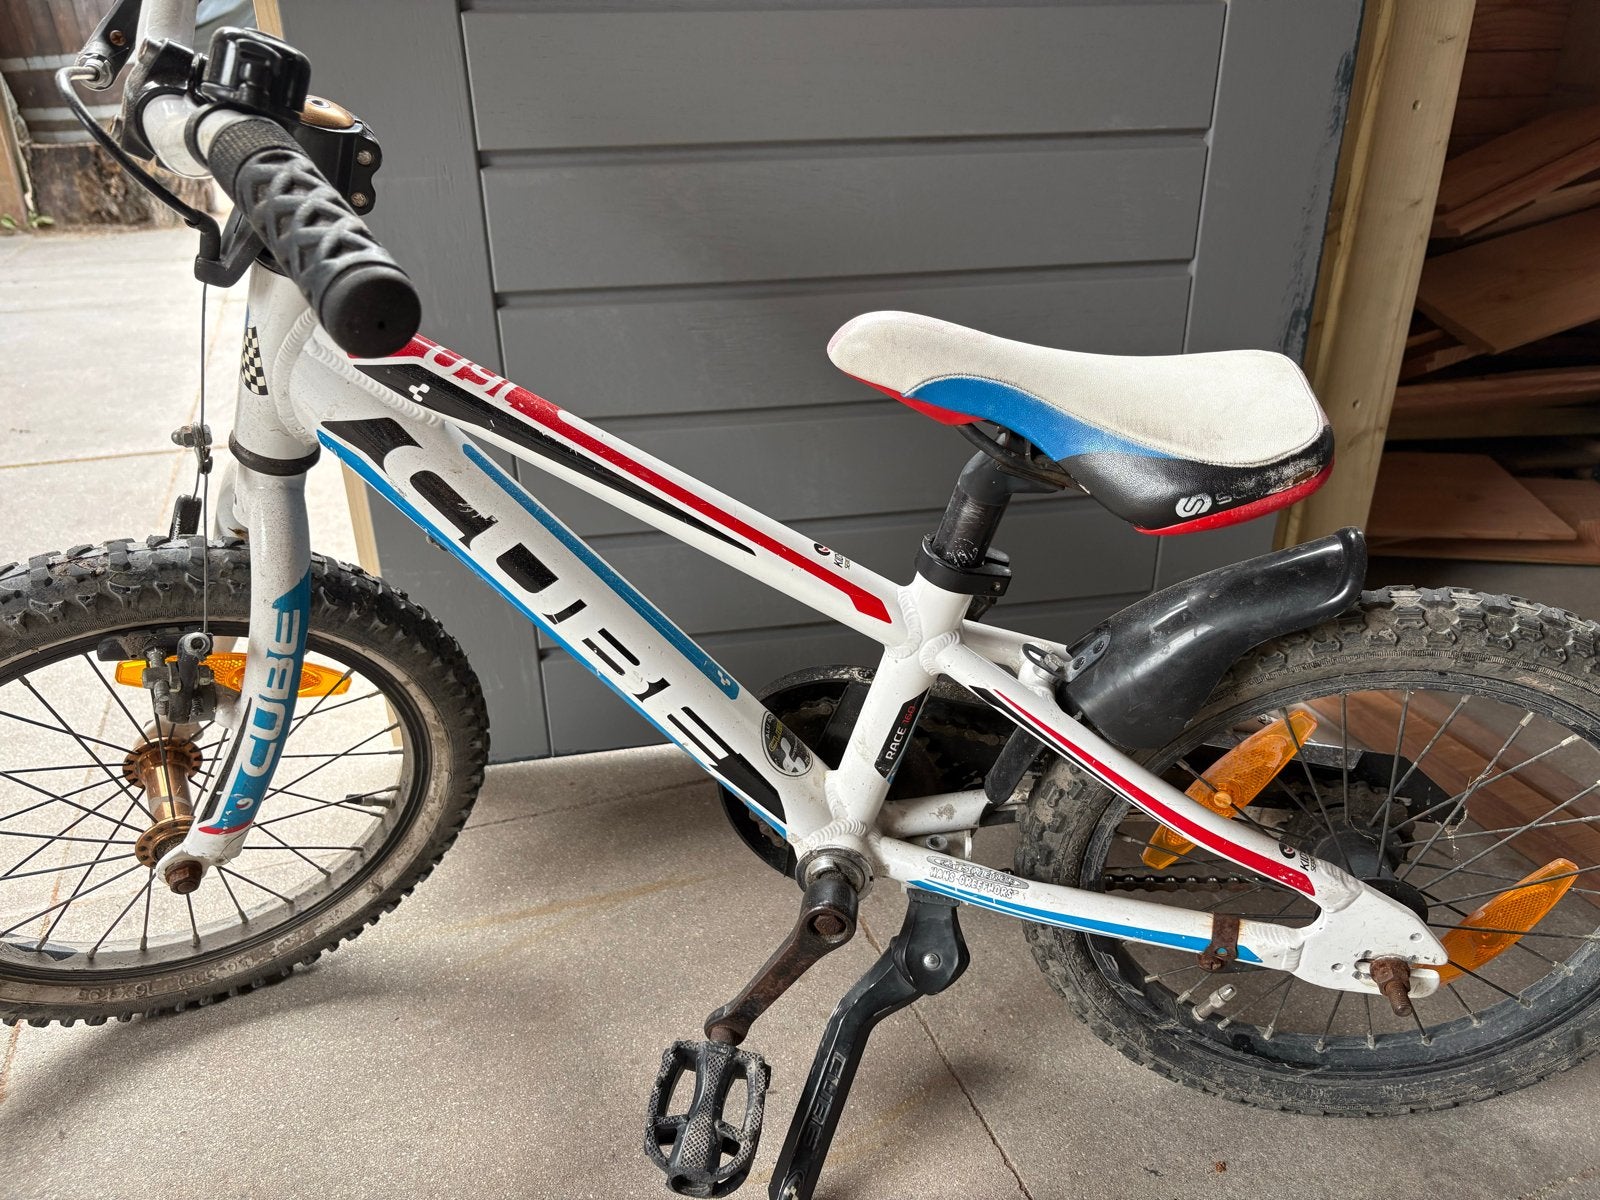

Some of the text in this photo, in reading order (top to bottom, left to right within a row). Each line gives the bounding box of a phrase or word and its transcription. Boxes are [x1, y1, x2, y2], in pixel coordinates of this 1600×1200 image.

[383, 444, 740, 771] CUBE
[241, 608, 301, 778] CUBE
[885, 704, 917, 760] RACE 160
[804, 1051, 848, 1152] CUBE
